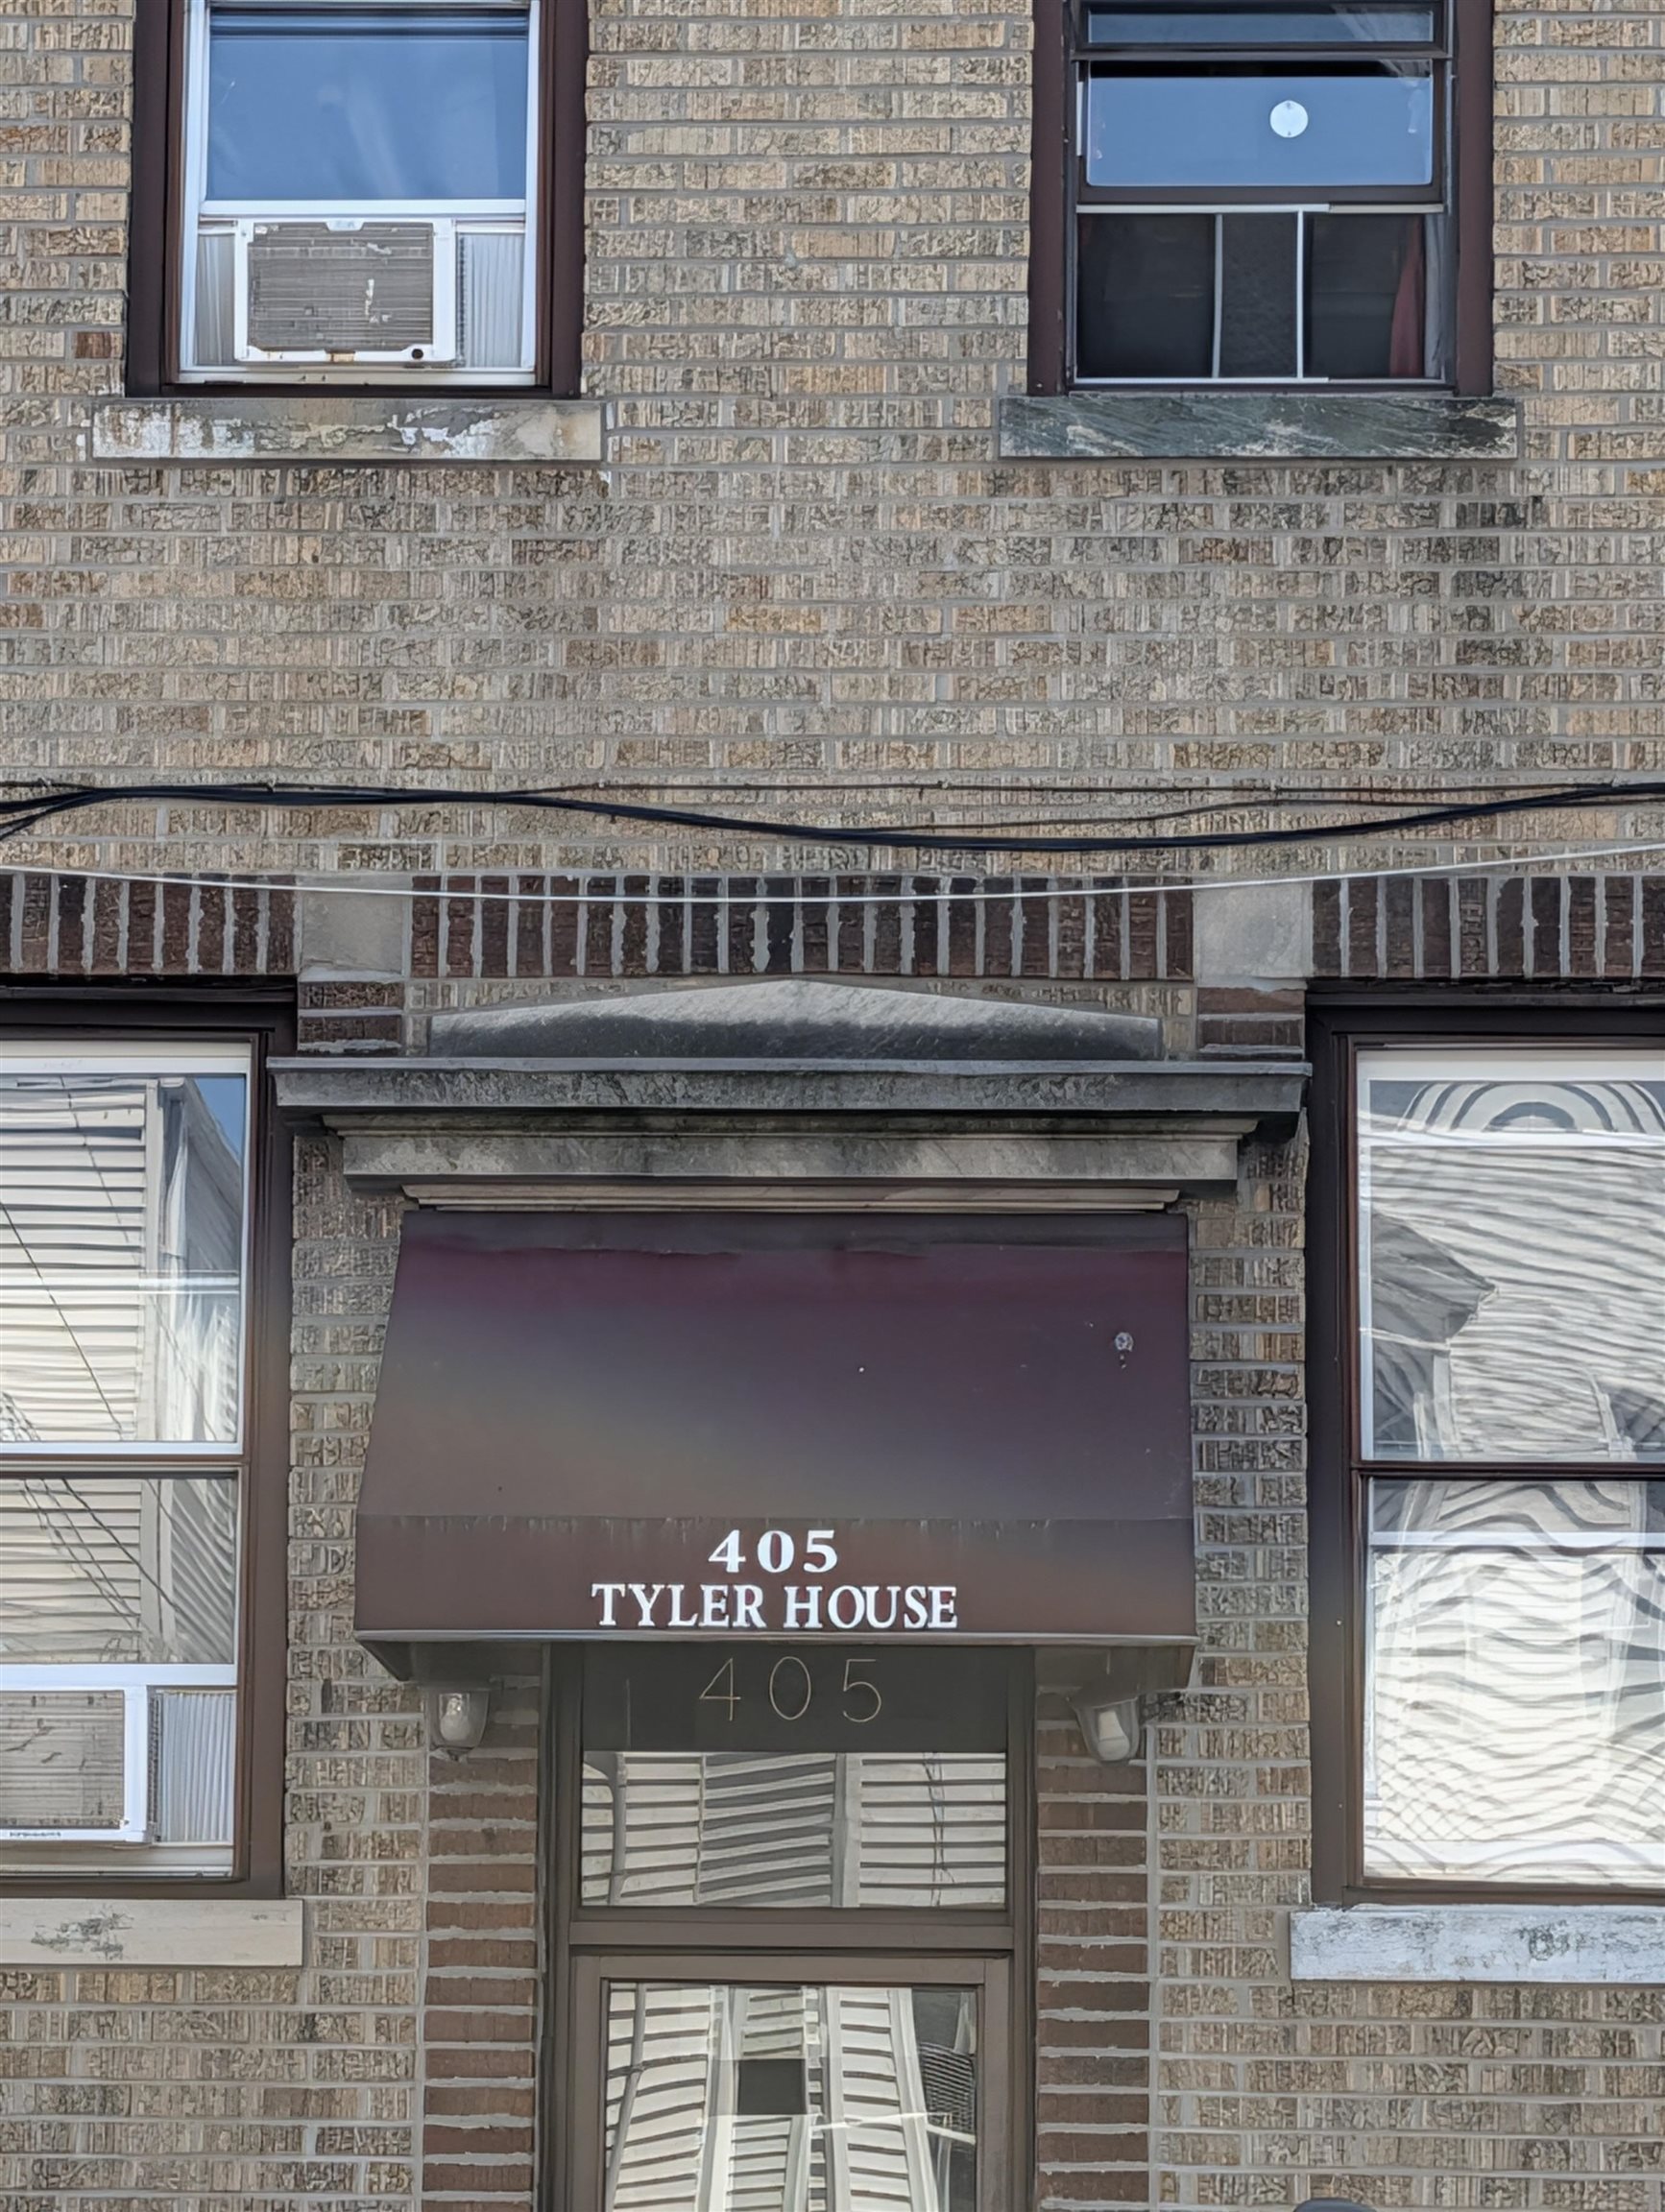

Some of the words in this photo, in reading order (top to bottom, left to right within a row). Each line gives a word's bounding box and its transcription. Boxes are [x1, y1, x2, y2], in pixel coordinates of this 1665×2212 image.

[708, 1529, 838, 1573] 405
[591, 1583, 767, 1626] TYLER
[783, 1585, 958, 1628] HOUSE
